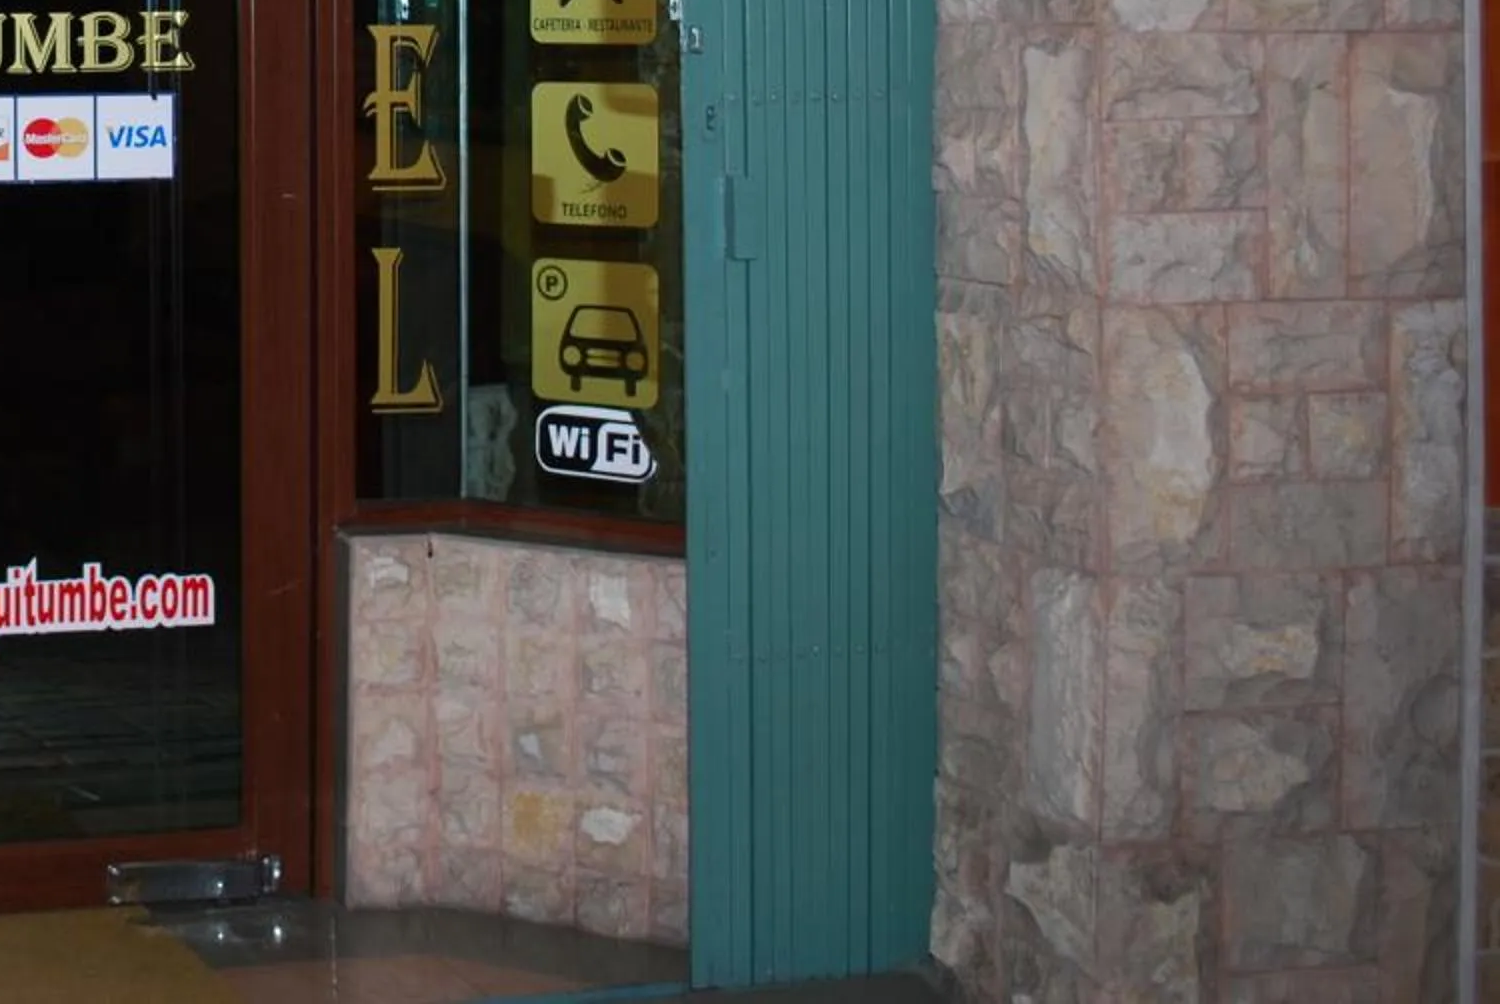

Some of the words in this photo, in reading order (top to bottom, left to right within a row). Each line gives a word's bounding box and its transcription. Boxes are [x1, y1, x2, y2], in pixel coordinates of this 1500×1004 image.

[533, 18, 582, 32] CAFETERIA
[587, 18, 655, 33] RESTAURANTE
[108, 126, 168, 149] VISA
[561, 202, 628, 219] TELEFONO
[545, 275, 558, 292] P
